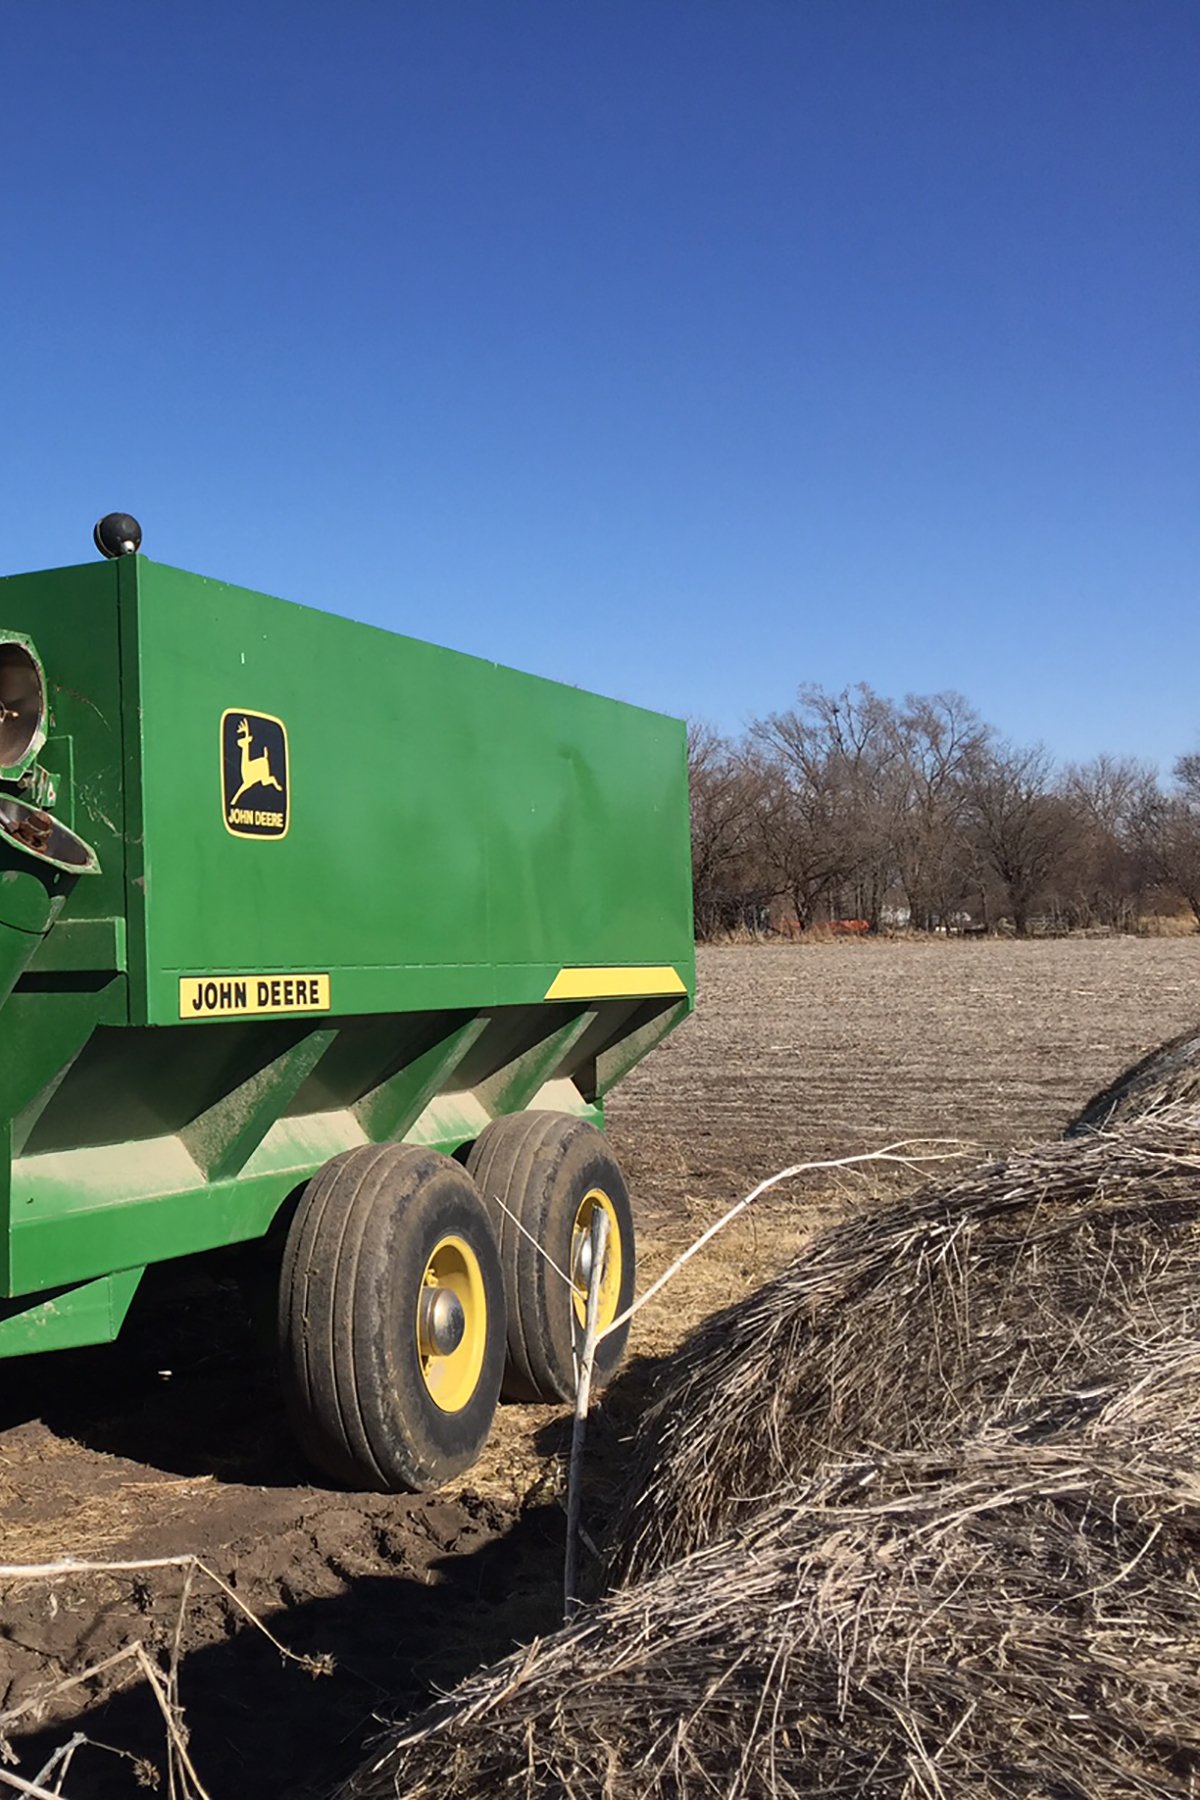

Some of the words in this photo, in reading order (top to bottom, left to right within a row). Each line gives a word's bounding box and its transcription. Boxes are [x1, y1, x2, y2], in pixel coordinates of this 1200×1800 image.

[228, 808, 254, 825] JOHN
[255, 811, 284, 828] DEERE
[192, 982, 247, 1011] JOHN
[257, 980, 320, 1007] DEERE
